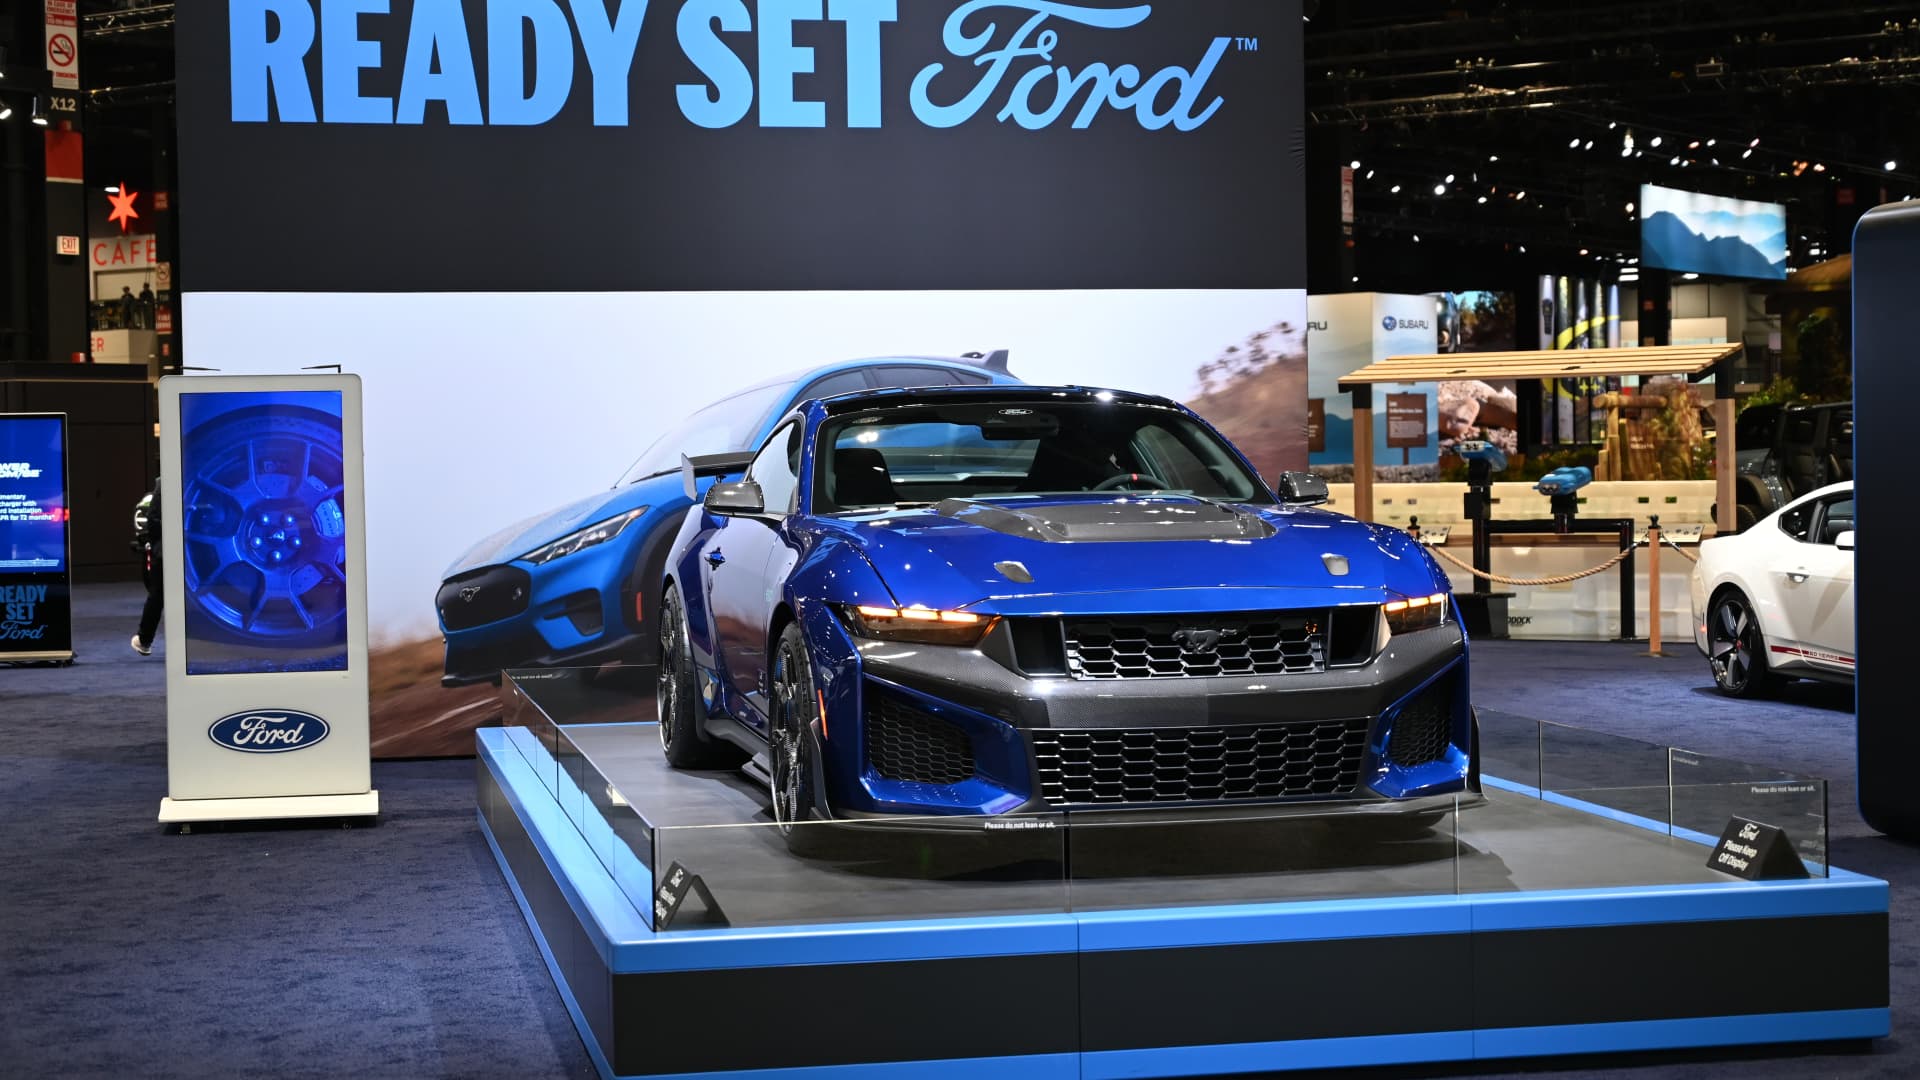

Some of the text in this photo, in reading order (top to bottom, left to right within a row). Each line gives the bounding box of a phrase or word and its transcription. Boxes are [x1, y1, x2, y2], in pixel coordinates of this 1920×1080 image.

[229, 0, 649, 126] READY
[675, 0, 898, 129] SET
[909, 0, 1232, 131] Ford
[50, 97, 77, 112] X12
[62, 238, 77, 250] EXIT
[1398, 319, 1429, 330] SUBARU
[6, 603, 35, 620] SET
[233, 716, 305, 745] Ford
[984, 822, 1004, 830] Please
[1723, 839, 1744, 854] Please
[1717, 852, 1750, 871] Off Display
